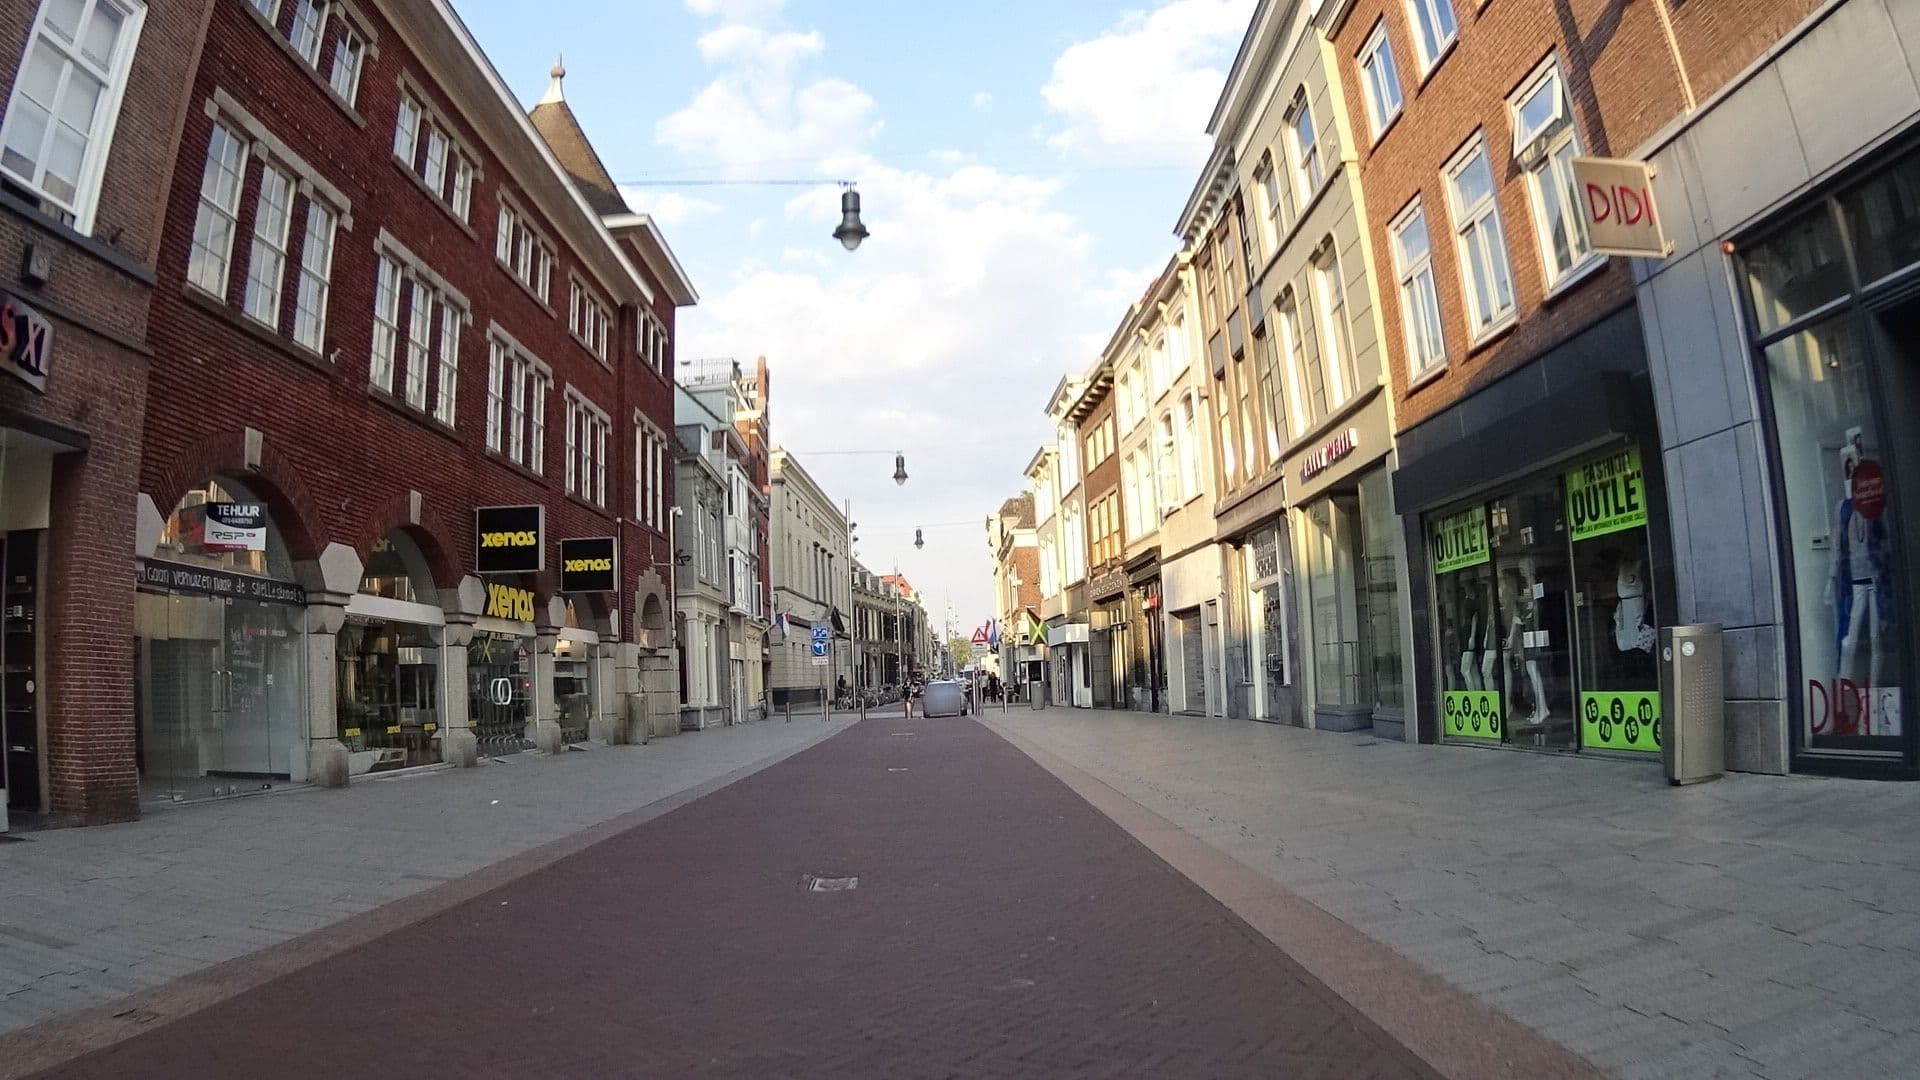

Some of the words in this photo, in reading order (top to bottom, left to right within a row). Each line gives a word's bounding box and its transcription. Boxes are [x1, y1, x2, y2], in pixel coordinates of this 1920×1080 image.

[1586, 184, 1654, 227] DIDI
[1583, 449, 1630, 484] FASHION
[1572, 471, 1641, 527] OUTLE
[217, 504, 229, 516] TE
[230, 504, 259, 517] HUUR
[481, 531, 536, 547] xenos
[1435, 519, 1484, 562] OUTLET
[565, 558, 611, 572] xenos
[487, 582, 535, 622] xenos
[1587, 702, 1597, 719] 15
[1614, 704, 1621, 719] 5
[1640, 704, 1651, 720] 10
[1808, 678, 1870, 735] DIDI
[1601, 721, 1610, 738] 10
[1626, 721, 1637, 739] 15
